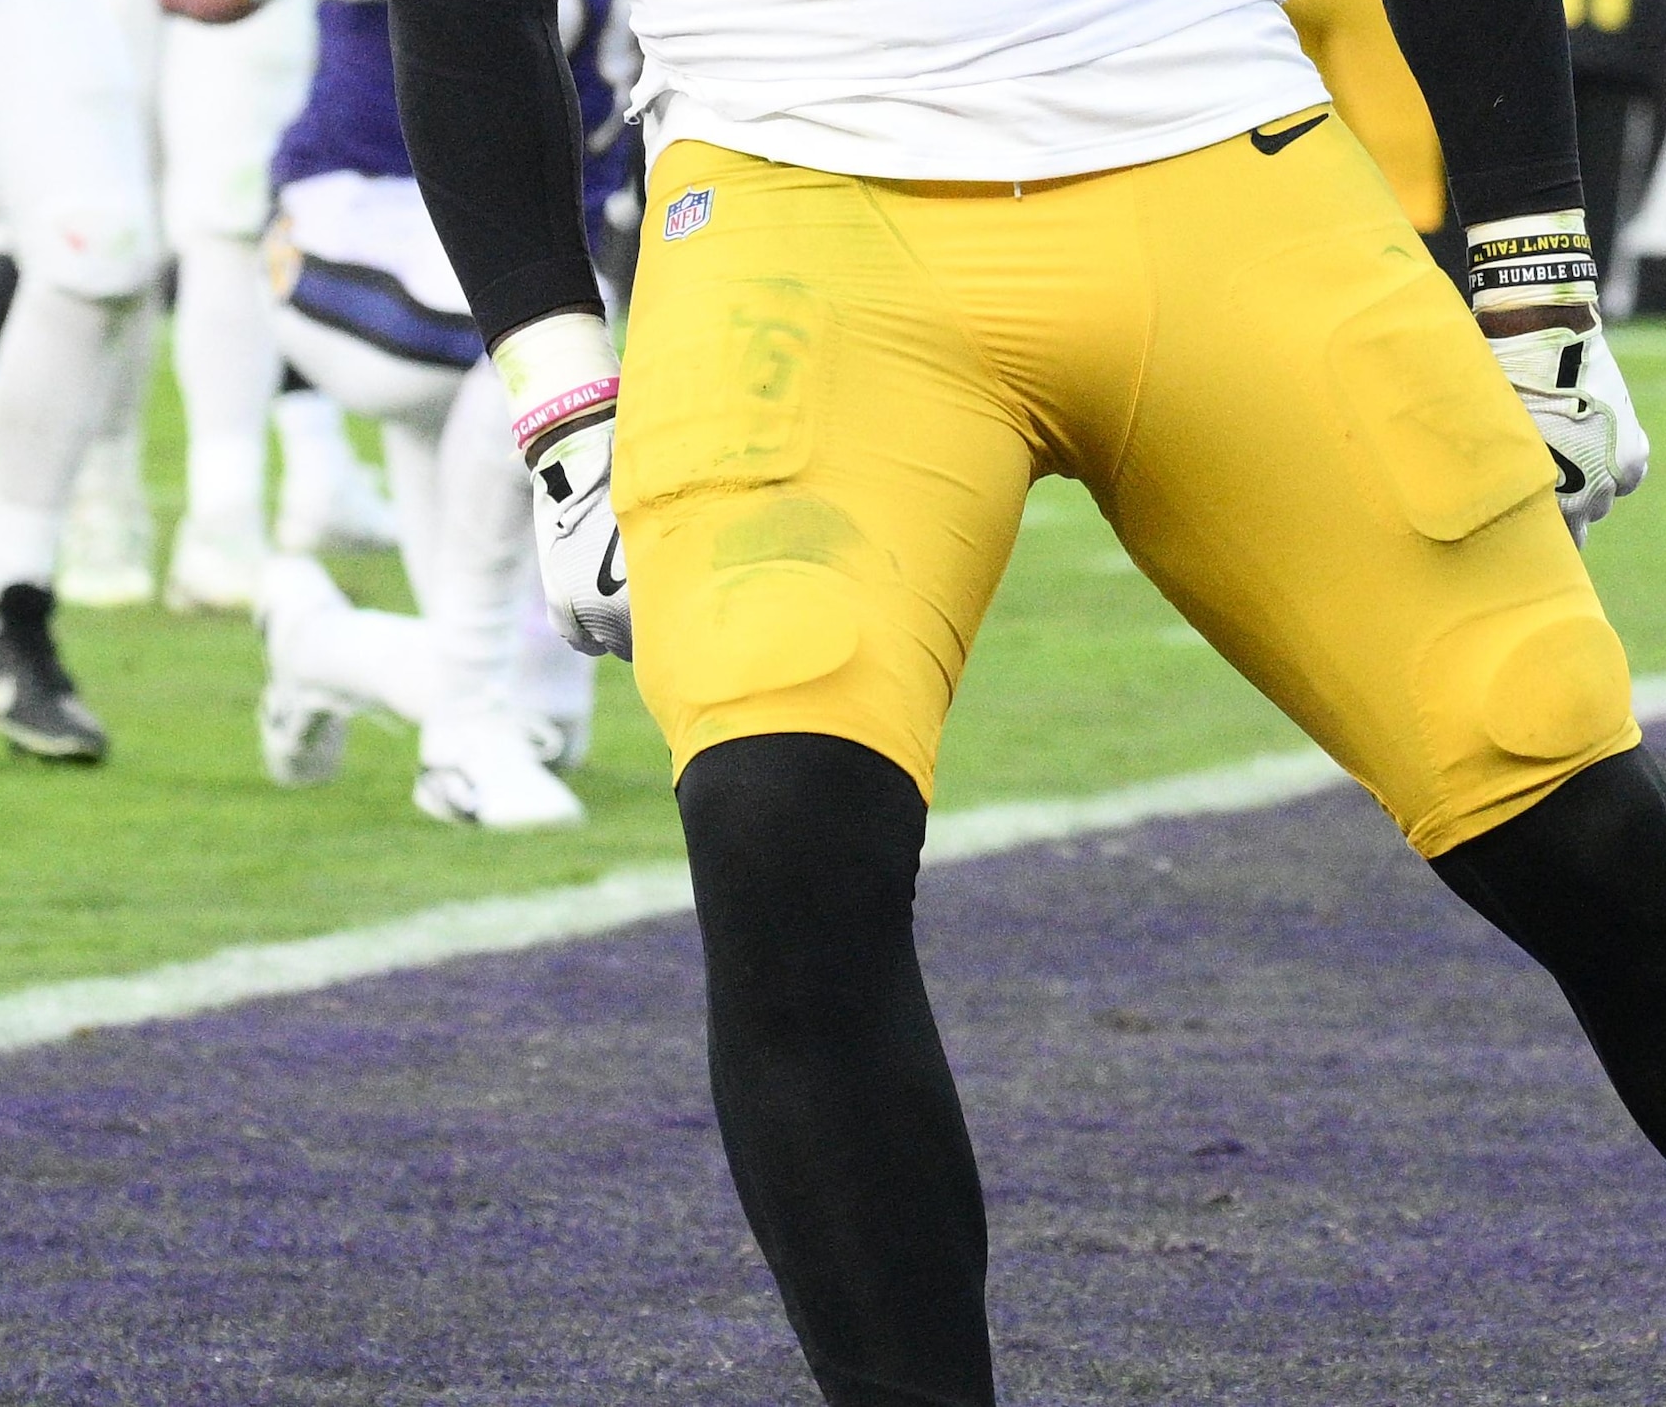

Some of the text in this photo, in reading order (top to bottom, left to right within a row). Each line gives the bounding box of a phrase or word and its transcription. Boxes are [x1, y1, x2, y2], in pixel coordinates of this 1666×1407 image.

[670, 206, 701, 233] NFL
[1522, 235, 1570, 253] CAN'T
[1498, 264, 1568, 285] HUMBLE
[1572, 262, 1598, 278] OVE
[520, 402, 560, 435] CAN'T
